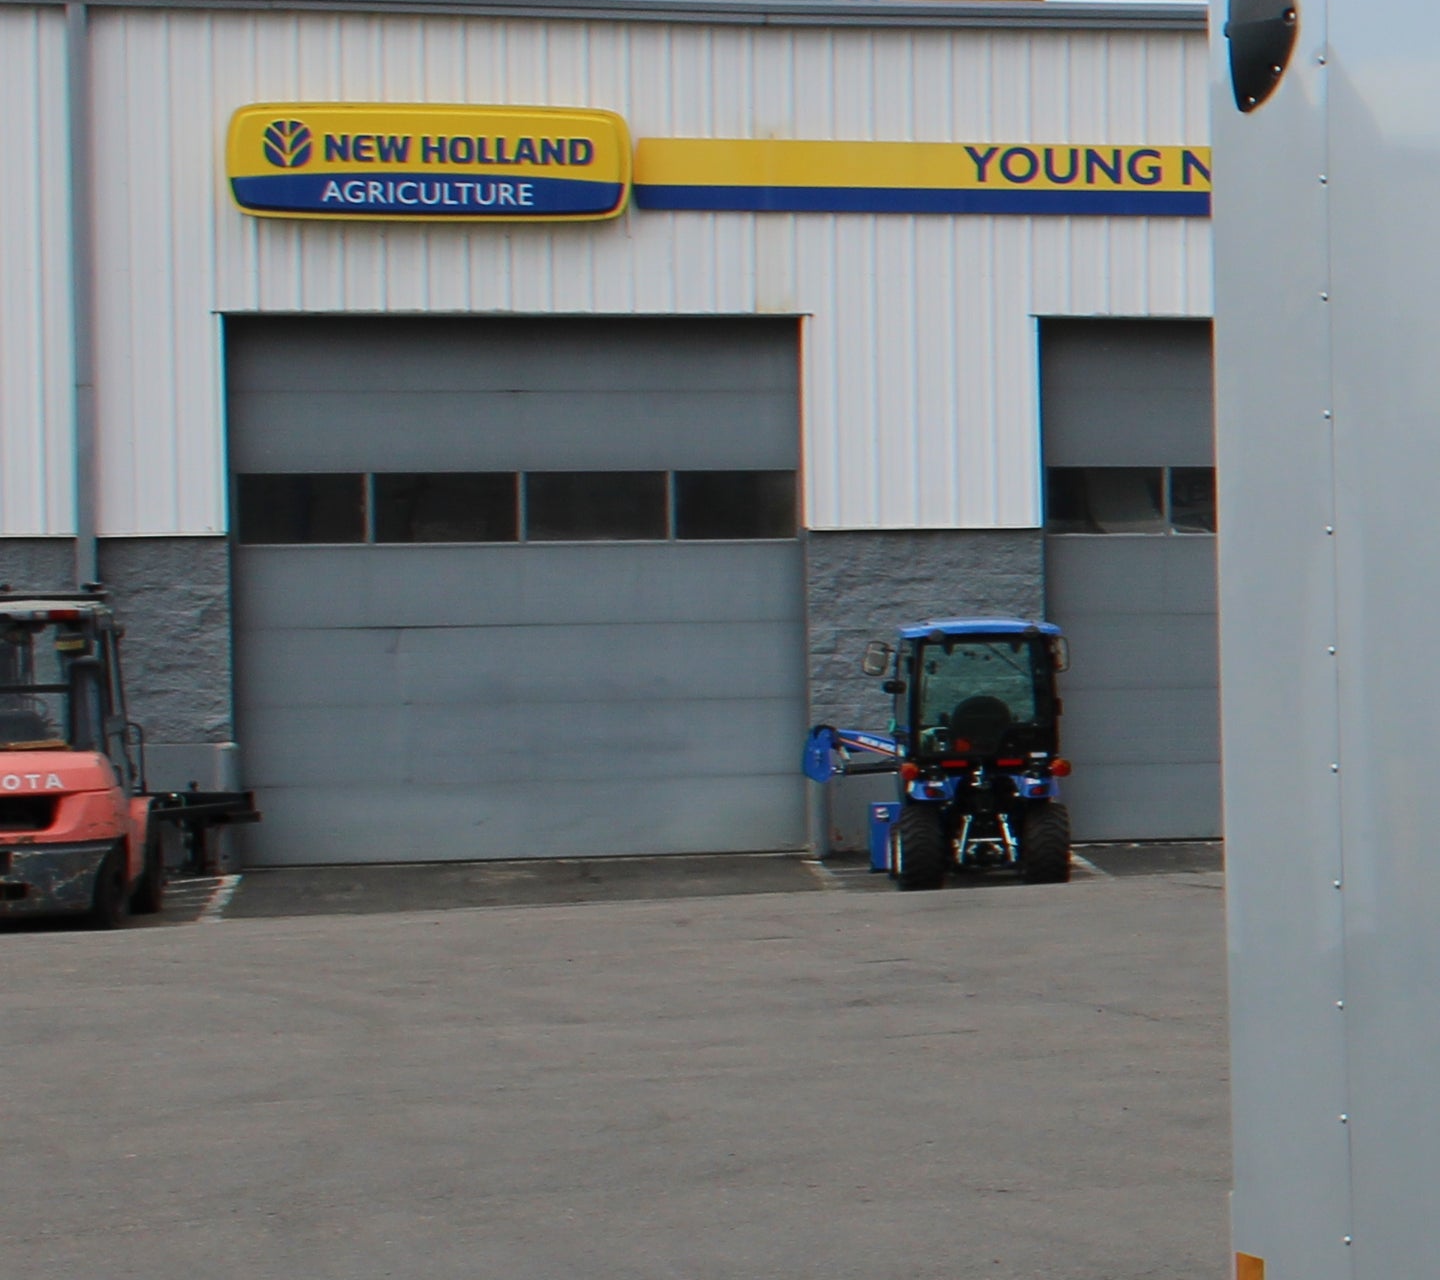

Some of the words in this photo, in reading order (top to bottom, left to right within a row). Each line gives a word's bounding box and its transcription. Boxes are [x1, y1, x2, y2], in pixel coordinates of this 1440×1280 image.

[323, 133, 411, 164] NEW
[421, 136, 594, 166] HOLLAND
[963, 145, 1163, 186] YOUNG
[321, 180, 535, 207] AGRICULTURE
